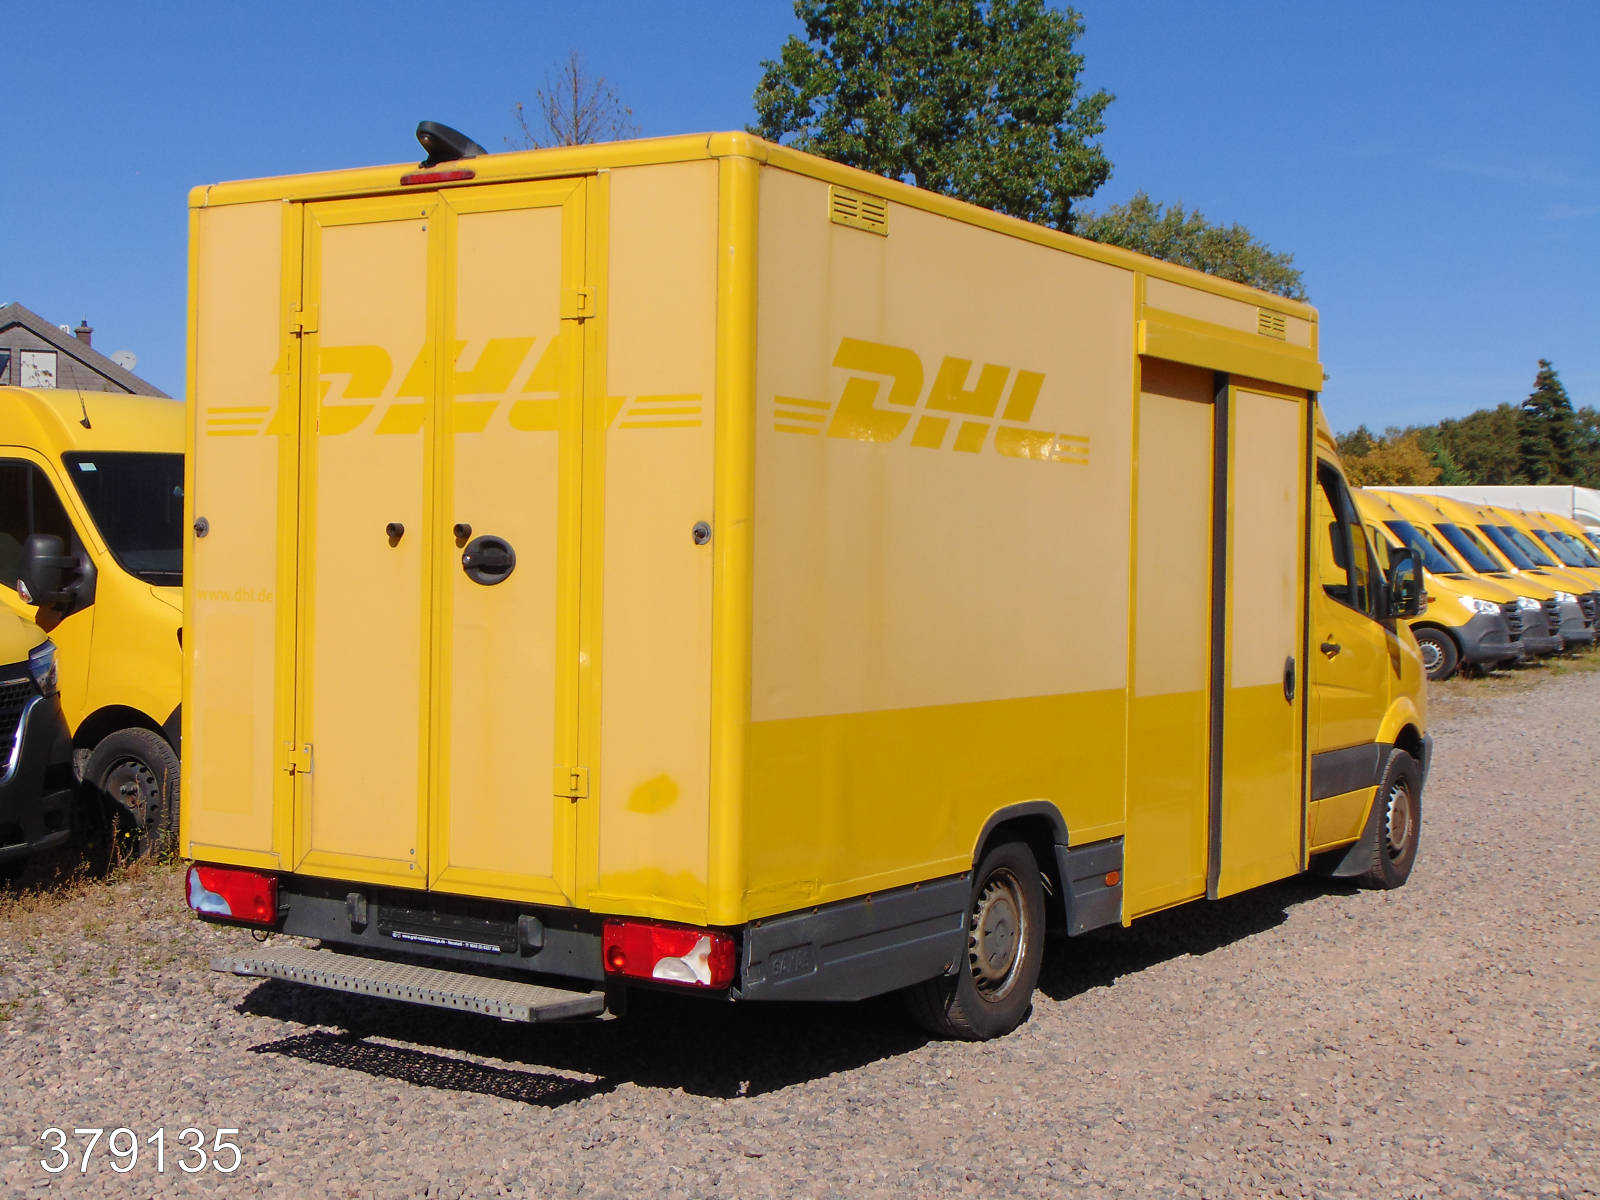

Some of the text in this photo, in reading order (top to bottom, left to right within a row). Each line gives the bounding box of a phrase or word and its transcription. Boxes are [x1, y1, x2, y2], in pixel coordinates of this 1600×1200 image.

[264, 336, 626, 436] DHL
[826, 337, 1056, 461] DHL
[196, 585, 273, 604] www.dhl.de
